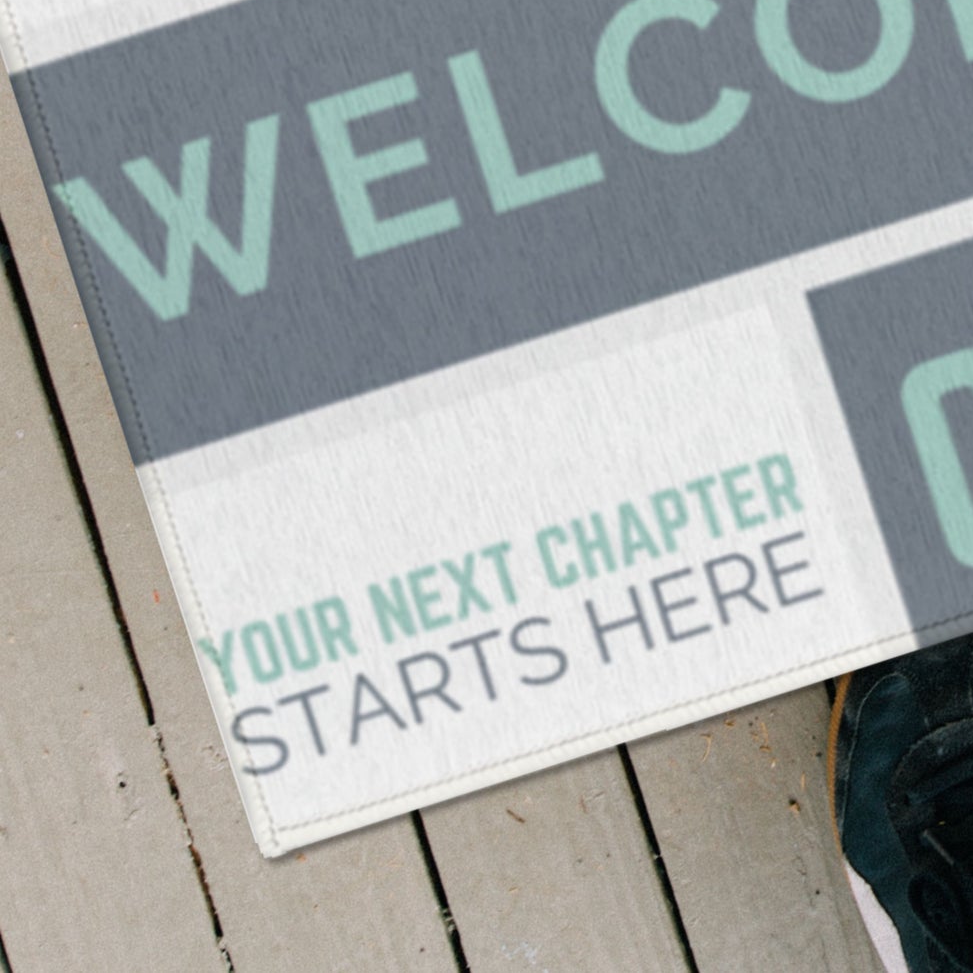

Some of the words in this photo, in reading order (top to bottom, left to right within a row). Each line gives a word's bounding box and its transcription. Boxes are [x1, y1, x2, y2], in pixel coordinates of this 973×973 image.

[198, 595, 360, 696] YOUR
[368, 540, 519, 644] NEXT
[534, 453, 804, 590] CHAPTER
[230, 615, 569, 777] STARTS
[584, 530, 824, 665] HERE
